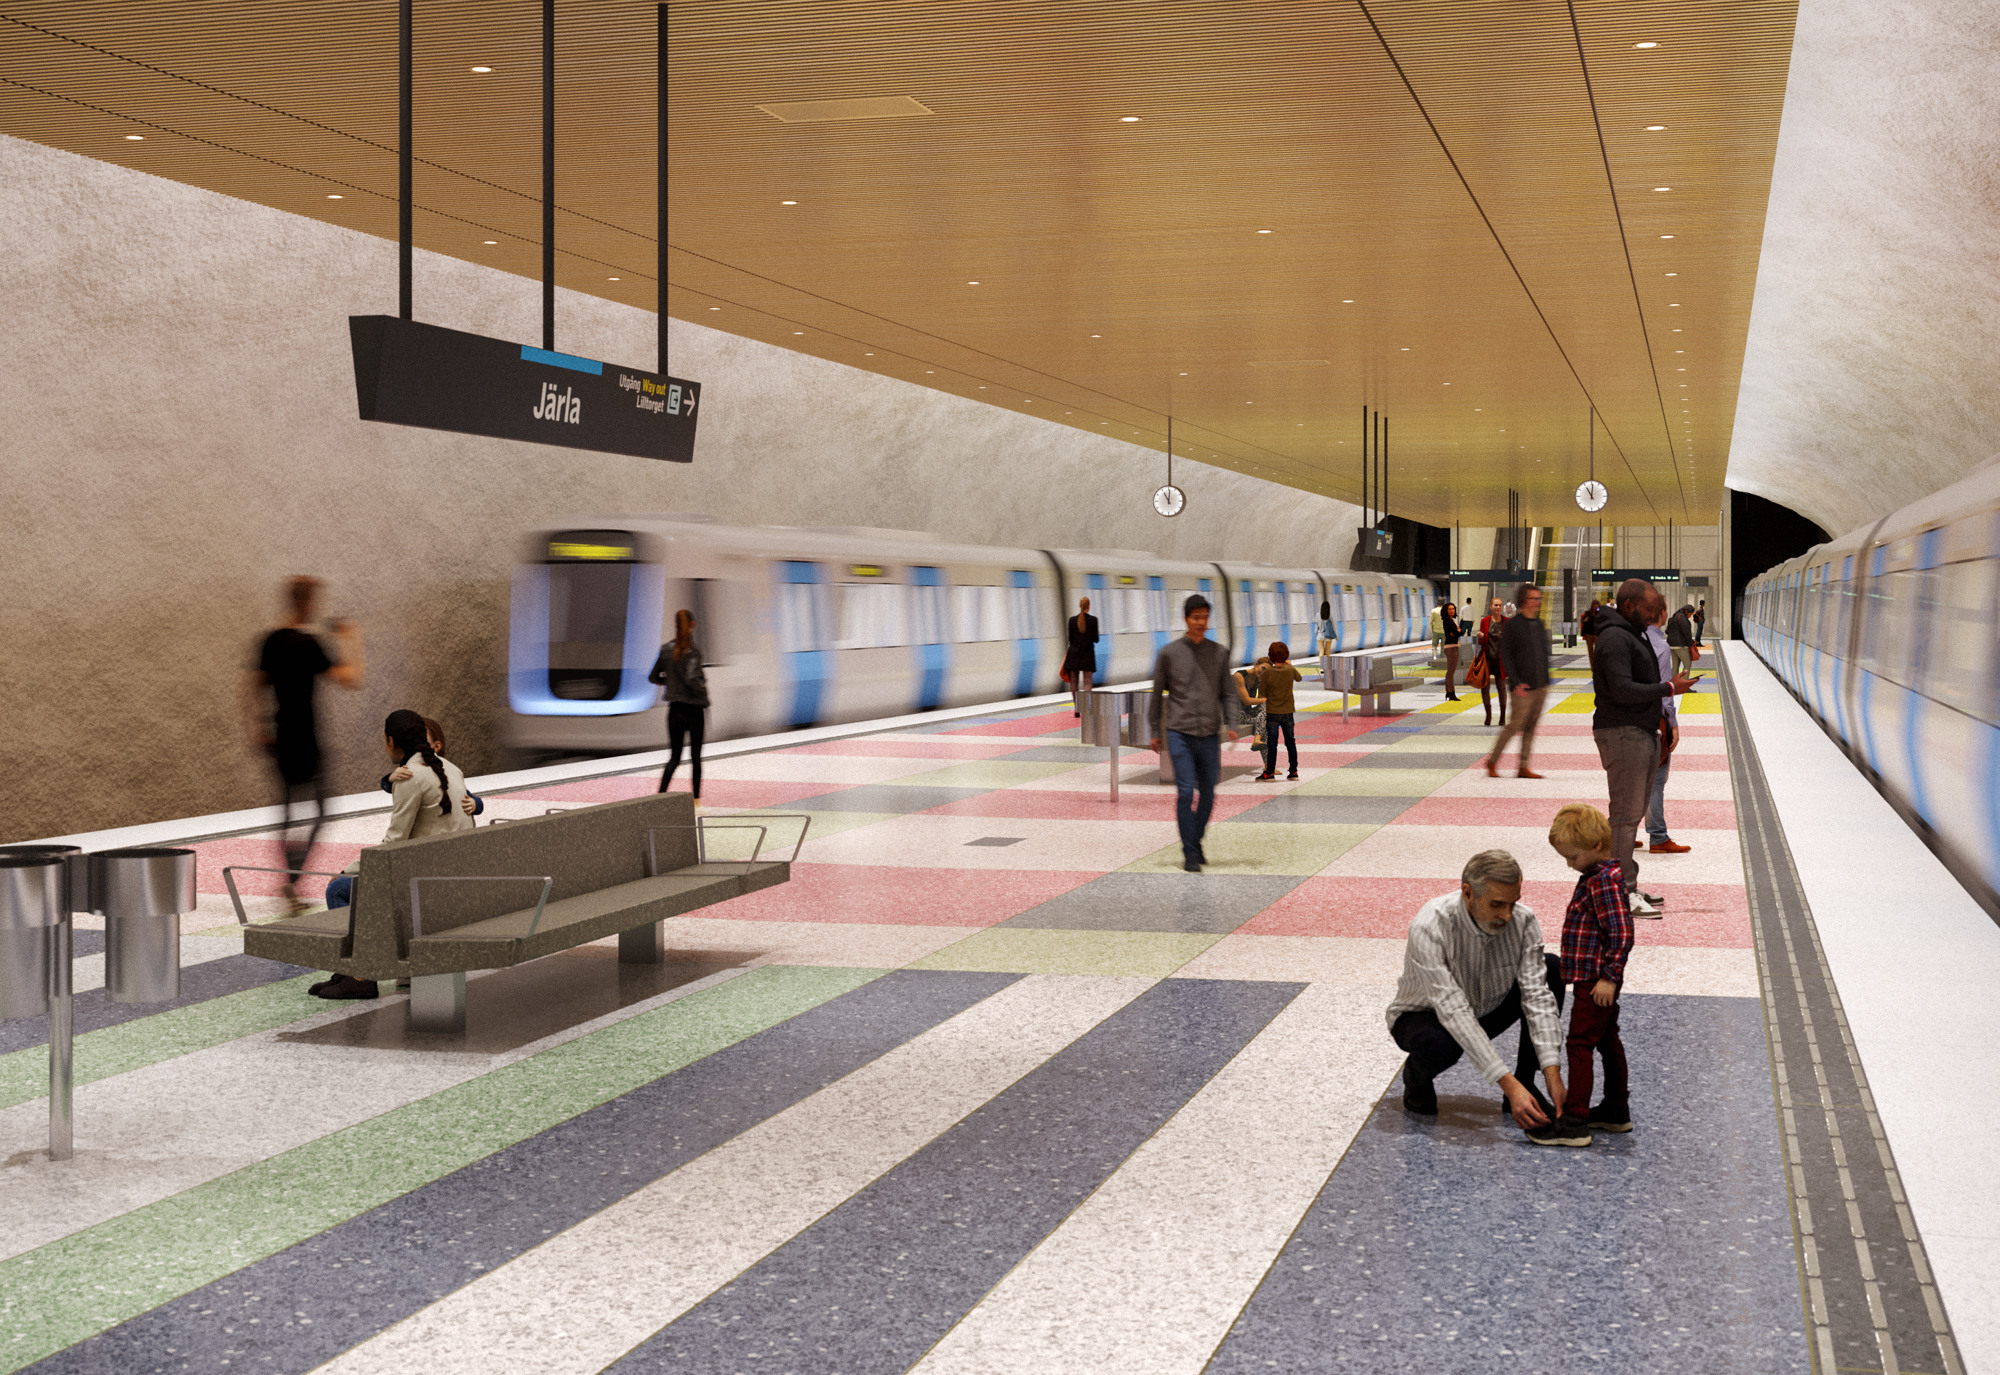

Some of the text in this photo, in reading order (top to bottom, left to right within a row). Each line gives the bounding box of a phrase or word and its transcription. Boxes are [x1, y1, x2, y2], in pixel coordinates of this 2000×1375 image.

[619, 373, 666, 396] Utgång Way out
[533, 381, 581, 425] Järla
